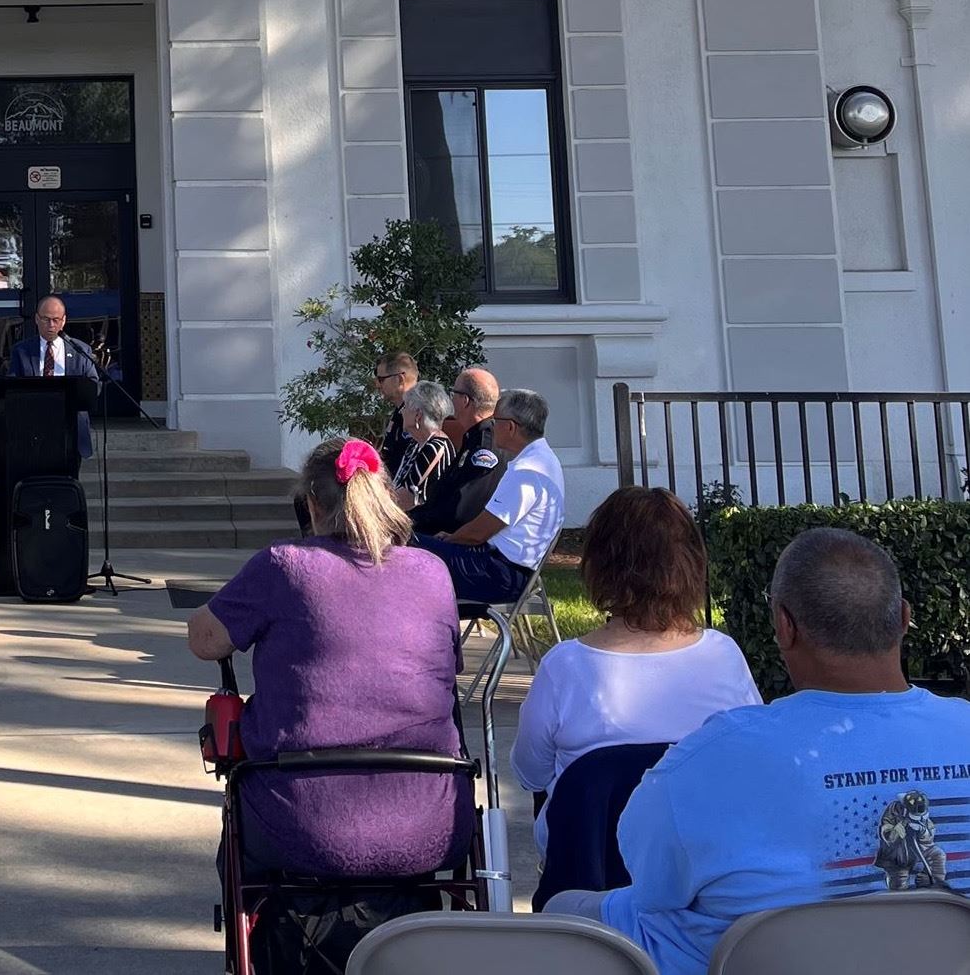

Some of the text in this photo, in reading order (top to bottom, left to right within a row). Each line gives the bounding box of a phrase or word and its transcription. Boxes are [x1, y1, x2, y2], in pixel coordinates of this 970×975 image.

[4, 119, 64, 132] BEAUMONT
[823, 763, 970, 790] STAND FOR THE FLA
